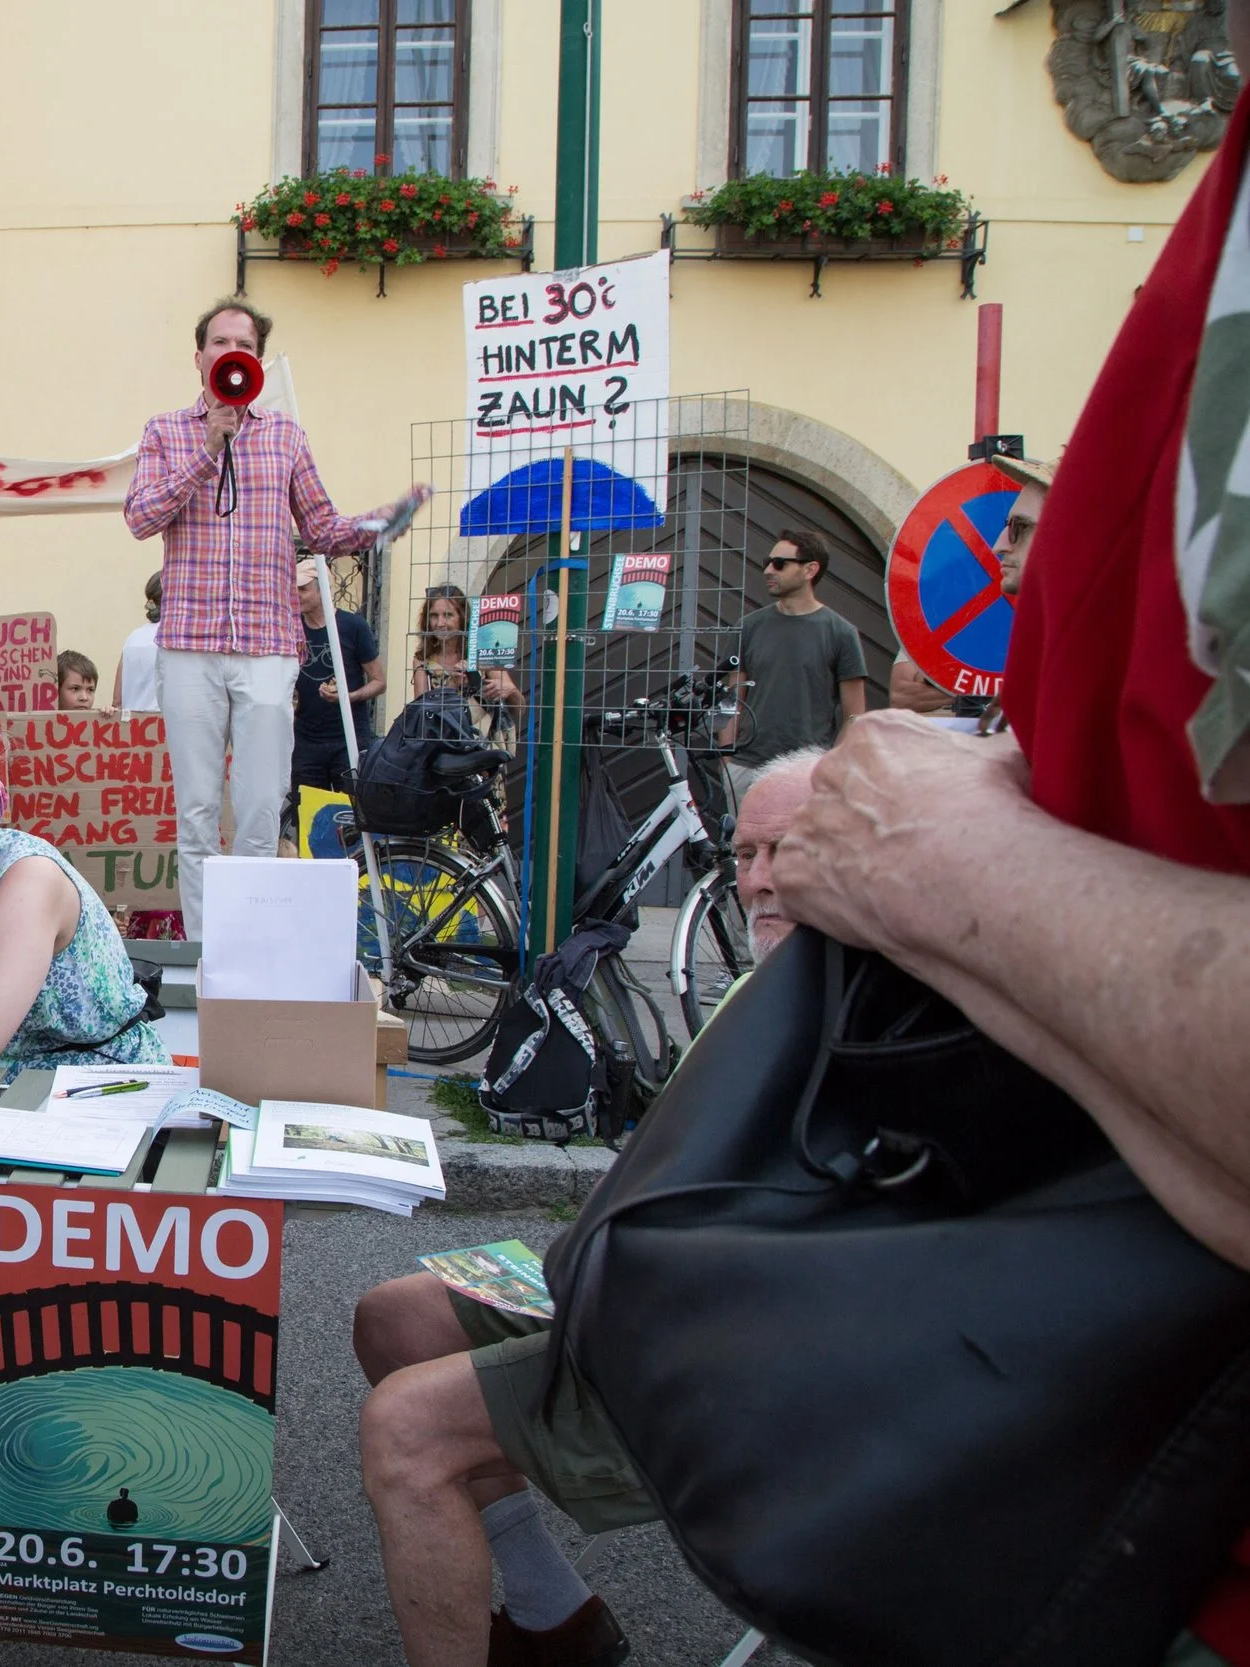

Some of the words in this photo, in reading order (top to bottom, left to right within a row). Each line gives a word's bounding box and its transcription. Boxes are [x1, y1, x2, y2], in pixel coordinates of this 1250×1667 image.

[479, 292, 529, 324] BEI
[478, 324, 639, 374] HINTERM
[477, 384, 586, 427] ZAUN
[625, 556, 668, 569] DEMO
[481, 596, 519, 609] DEMO
[15, 818, 138, 846] GANG
[126, 1542, 248, 1580] 17:30
[103, 1582, 247, 1607] Perchtoldsdorf
